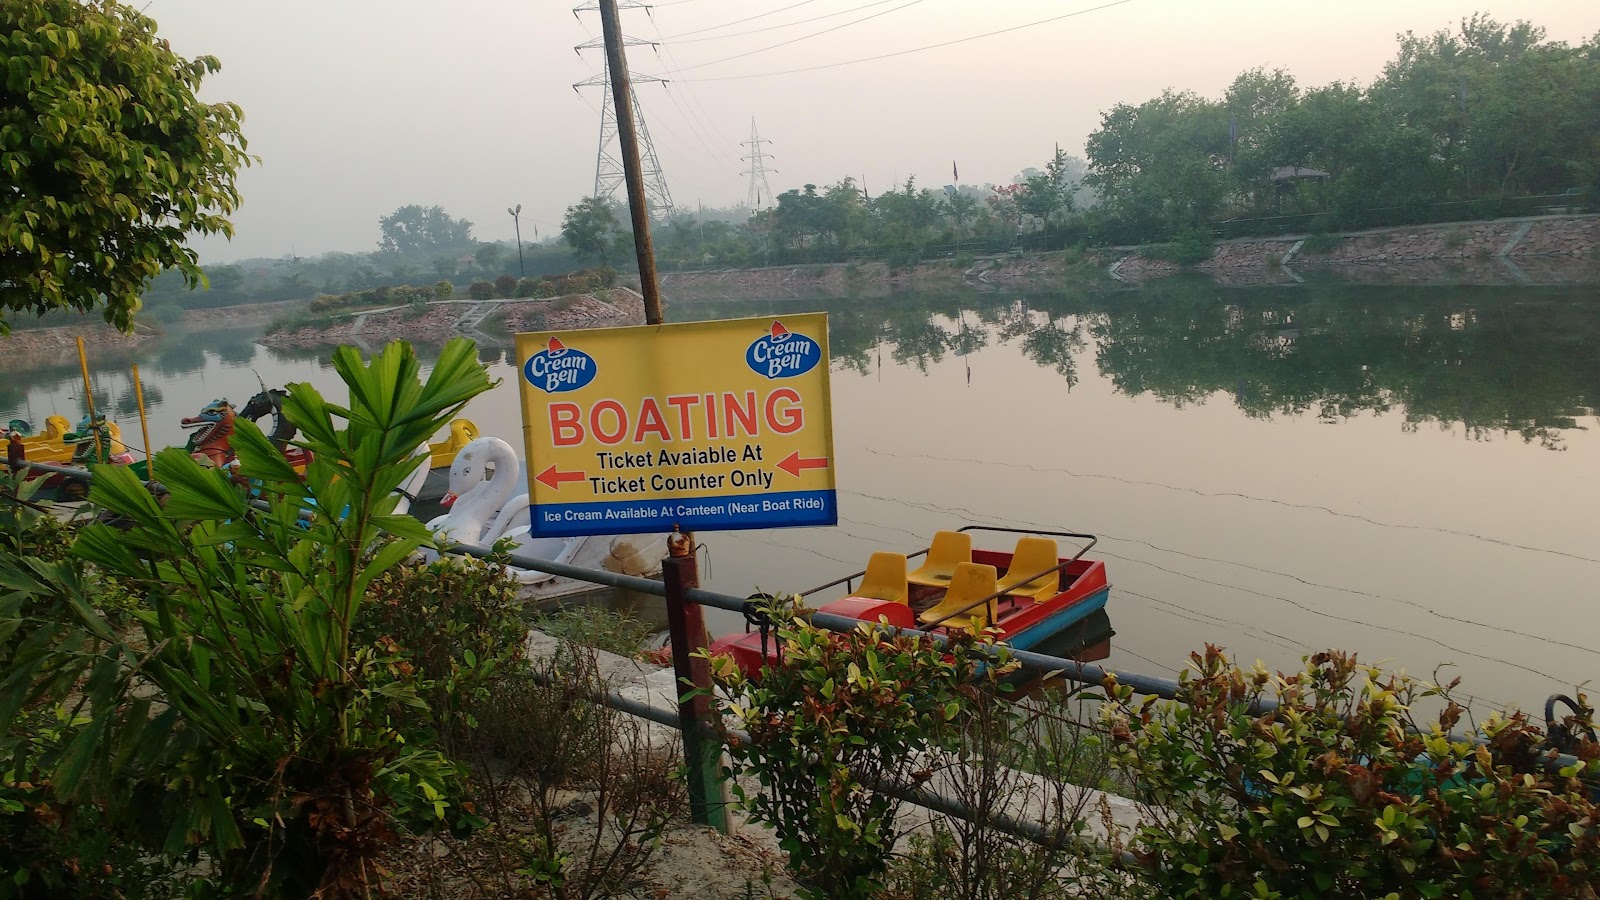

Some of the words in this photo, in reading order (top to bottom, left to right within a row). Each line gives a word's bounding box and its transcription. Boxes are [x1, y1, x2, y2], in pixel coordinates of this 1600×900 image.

[754, 340, 810, 361] Cream
[532, 356, 586, 376] Cream
[768, 355, 801, 377] Bell
[546, 371, 577, 392] Bell
[549, 388, 804, 447] BOATING
[596, 452, 653, 469] Ticket
[658, 446, 736, 466] Avaiable
[742, 445, 762, 461] At
[589, 475, 646, 494] Ticket
[651, 473, 724, 492] Counter
[731, 469, 773, 489] Only
[545, 511, 562, 522] Ice
[565, 509, 602, 521] Cream
[605, 506, 658, 519] Available
[661, 507, 673, 517] At
[677, 504, 724, 516] Canteen
[728, 502, 759, 515] (Near
[763, 500, 790, 512] Boat
[793, 498, 825, 511] Ride)
